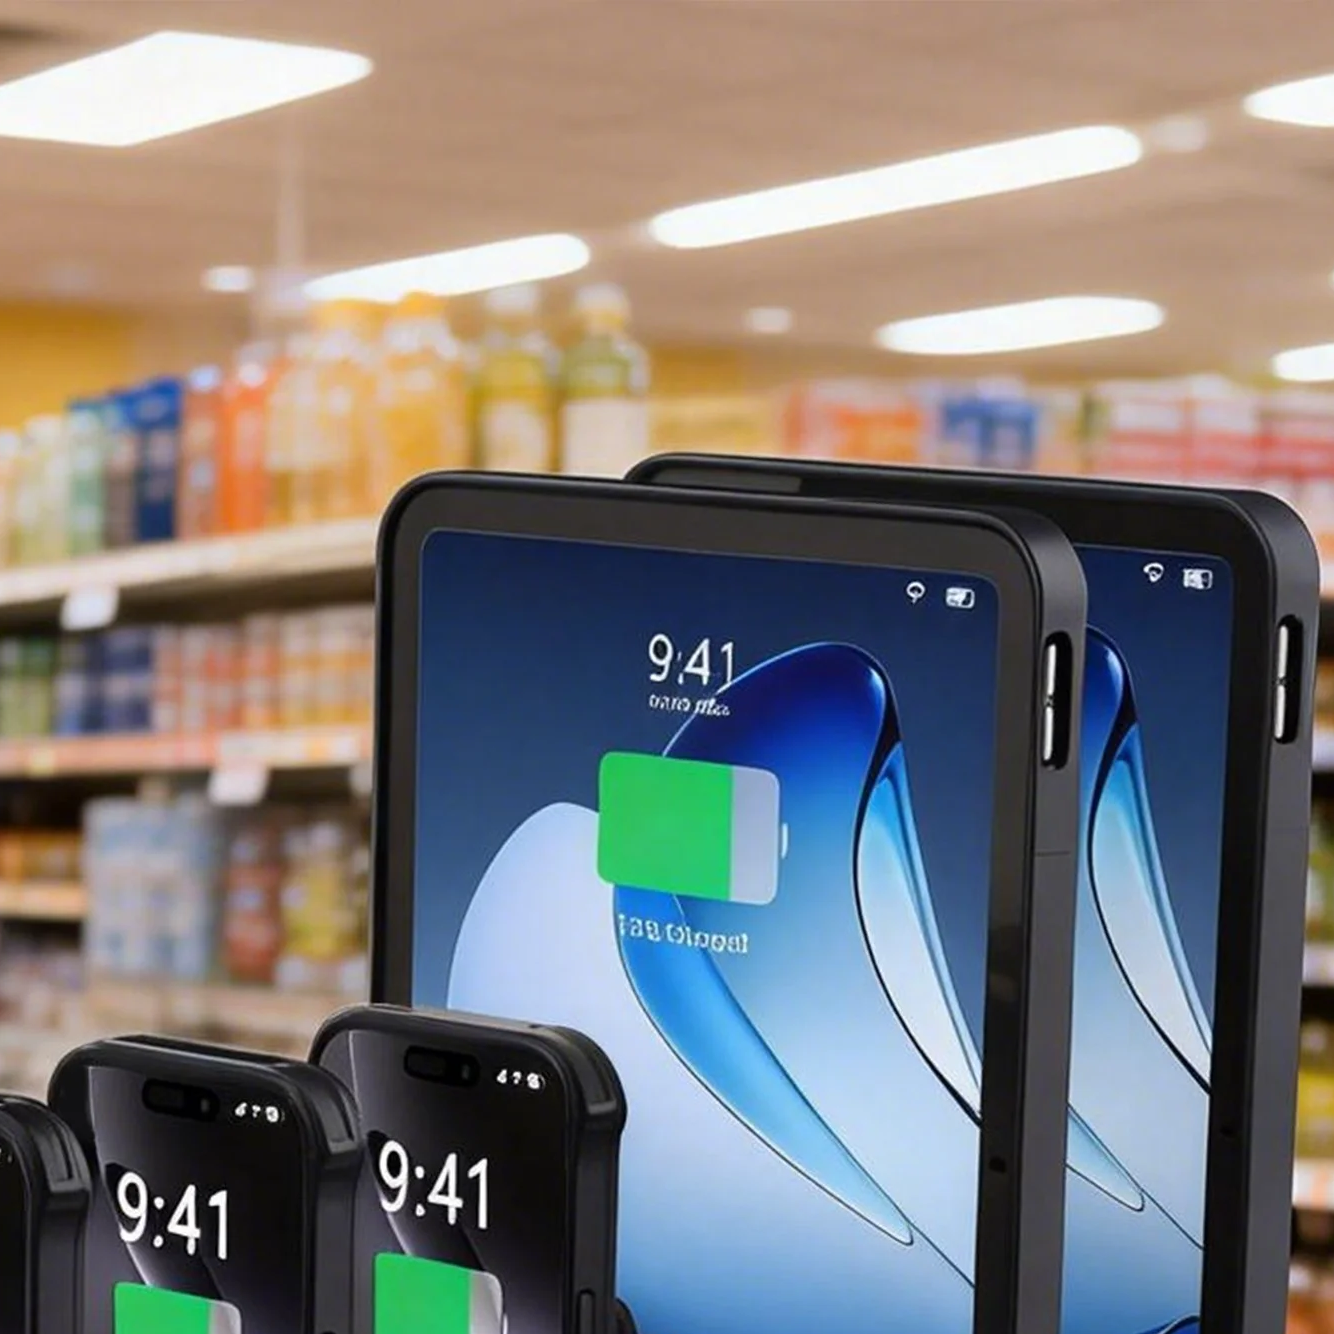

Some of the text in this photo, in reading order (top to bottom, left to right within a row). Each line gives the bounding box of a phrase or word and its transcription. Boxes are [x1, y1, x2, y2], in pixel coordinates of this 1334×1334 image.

[648, 633, 736, 687] 9:41
[117, 1172, 227, 1261] 9:41
[378, 1140, 488, 1230] 9:41
